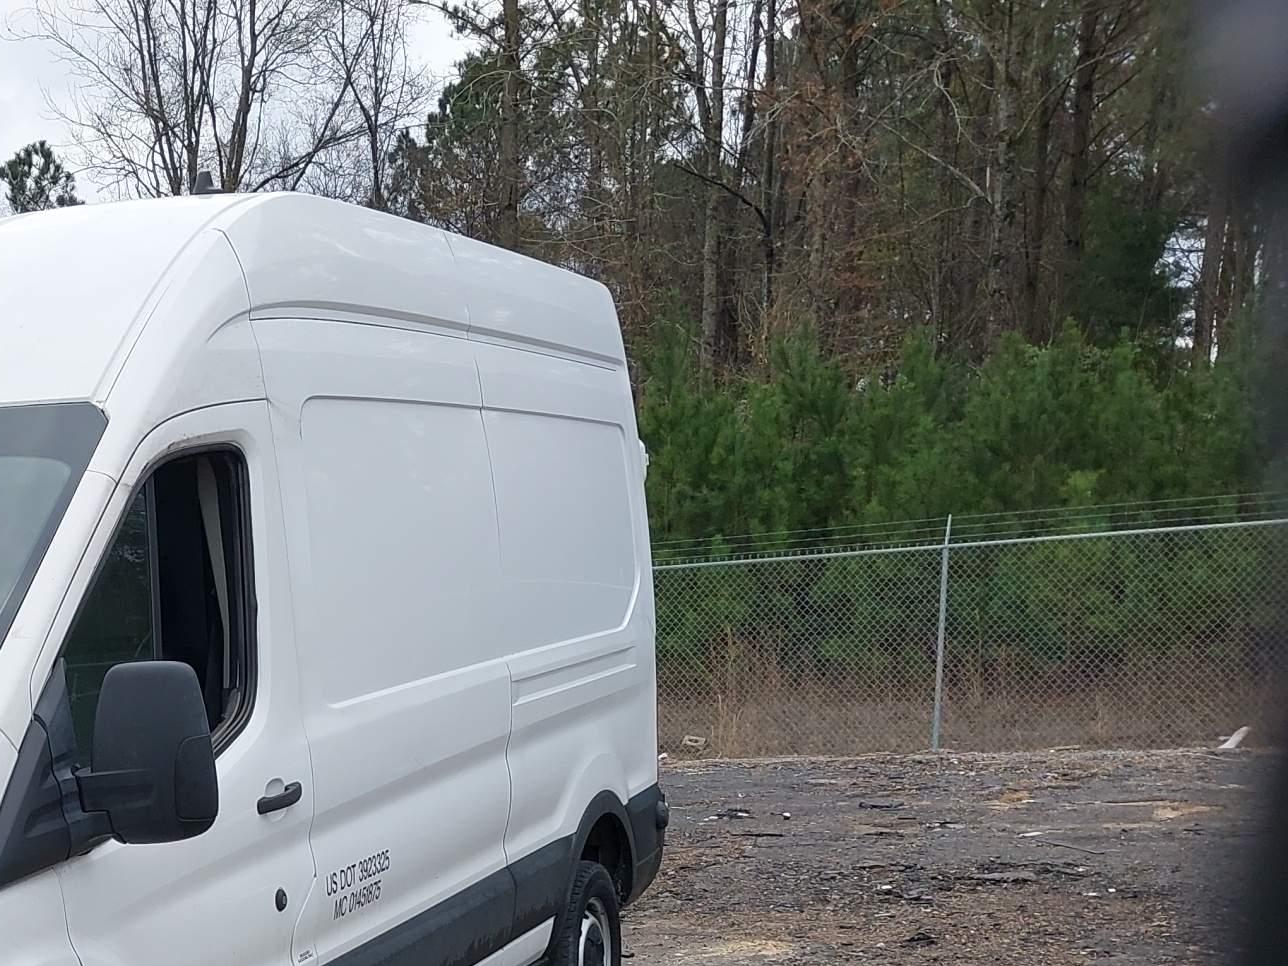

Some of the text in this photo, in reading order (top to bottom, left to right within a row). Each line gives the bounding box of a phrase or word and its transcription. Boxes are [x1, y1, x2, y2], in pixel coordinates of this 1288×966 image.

[326, 849, 390, 896] US DOT 3923325
[333, 896, 348, 920] MC
